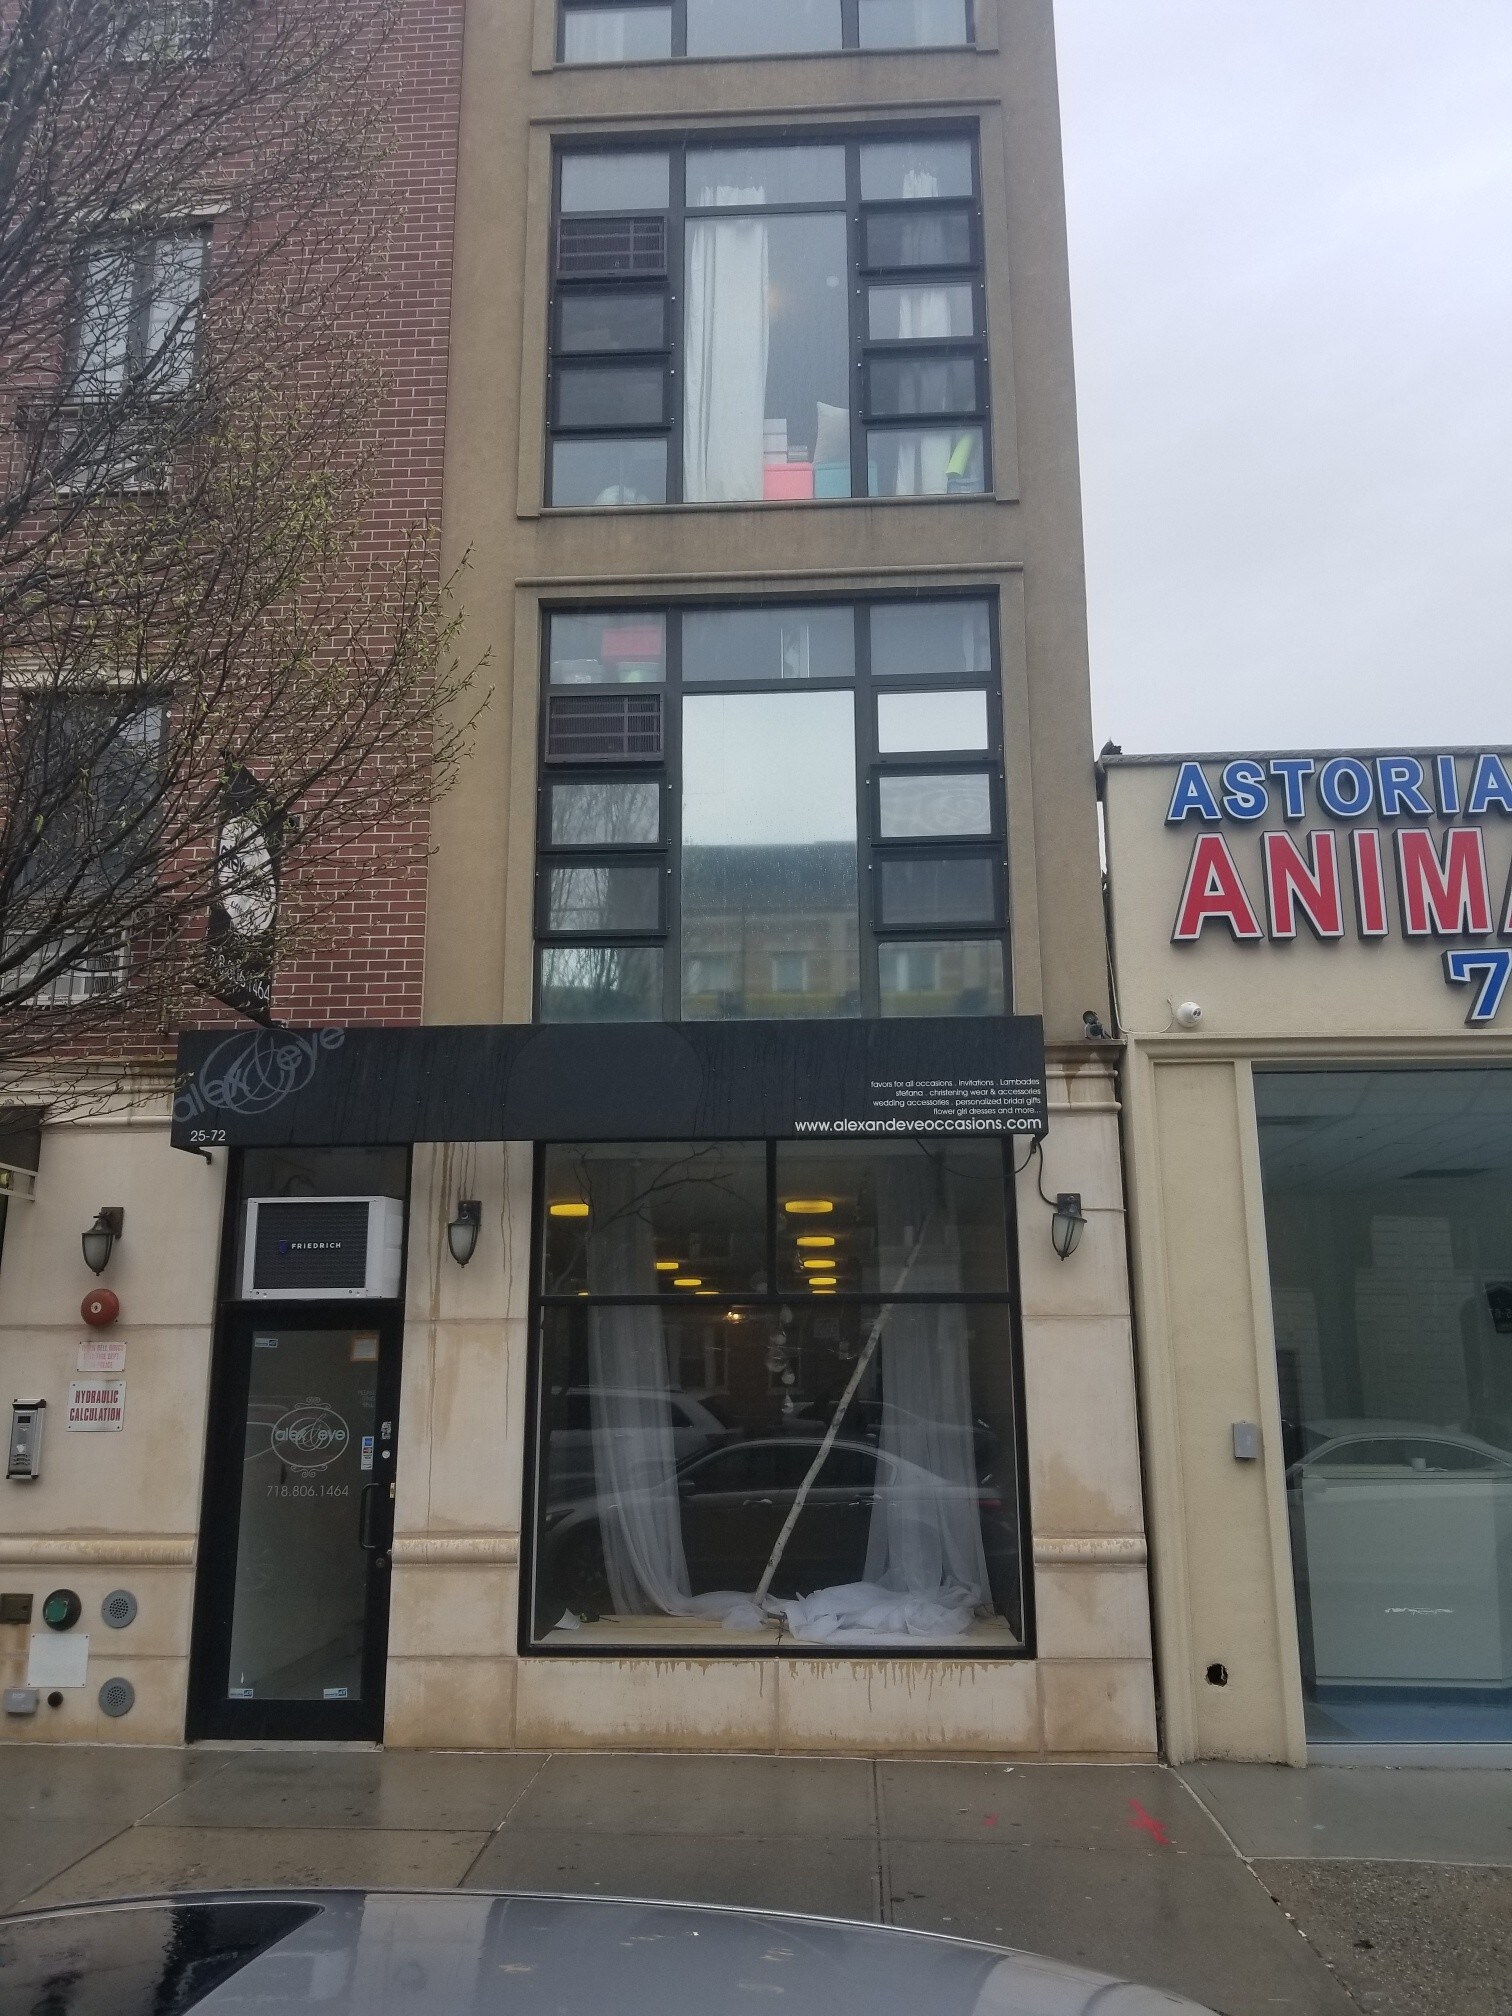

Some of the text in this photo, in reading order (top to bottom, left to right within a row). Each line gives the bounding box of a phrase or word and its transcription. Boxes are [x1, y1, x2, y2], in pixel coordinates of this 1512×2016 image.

[1165, 754, 1512, 823] ASTORIA
[1171, 826, 1512, 942] ANIM
[1442, 947, 1512, 1022] 7
[870, 1080, 893, 1088] favors
[1000, 1078, 1040, 1086] Lambades
[929, 1089, 969, 1097] christening
[872, 1099, 905, 1108] wedding
[955, 1098, 1002, 1106] personalized
[1003, 1097, 1025, 1105] bridal
[1026, 1097, 1041, 1105] gifts
[956, 1107, 968, 1117] girl
[968, 1107, 996, 1115] dresses
[794, 1116, 1042, 1132] www.alexandeveoccasions.com
[190, 1129, 226, 1142] 25-72
[291, 1242, 341, 1250] FRIEDRICH
[74, 1389, 119, 1404] HYDRAULIC
[69, 1407, 121, 1422] CALCULATION
[266, 1485, 349, 1497] 718.806.1464
